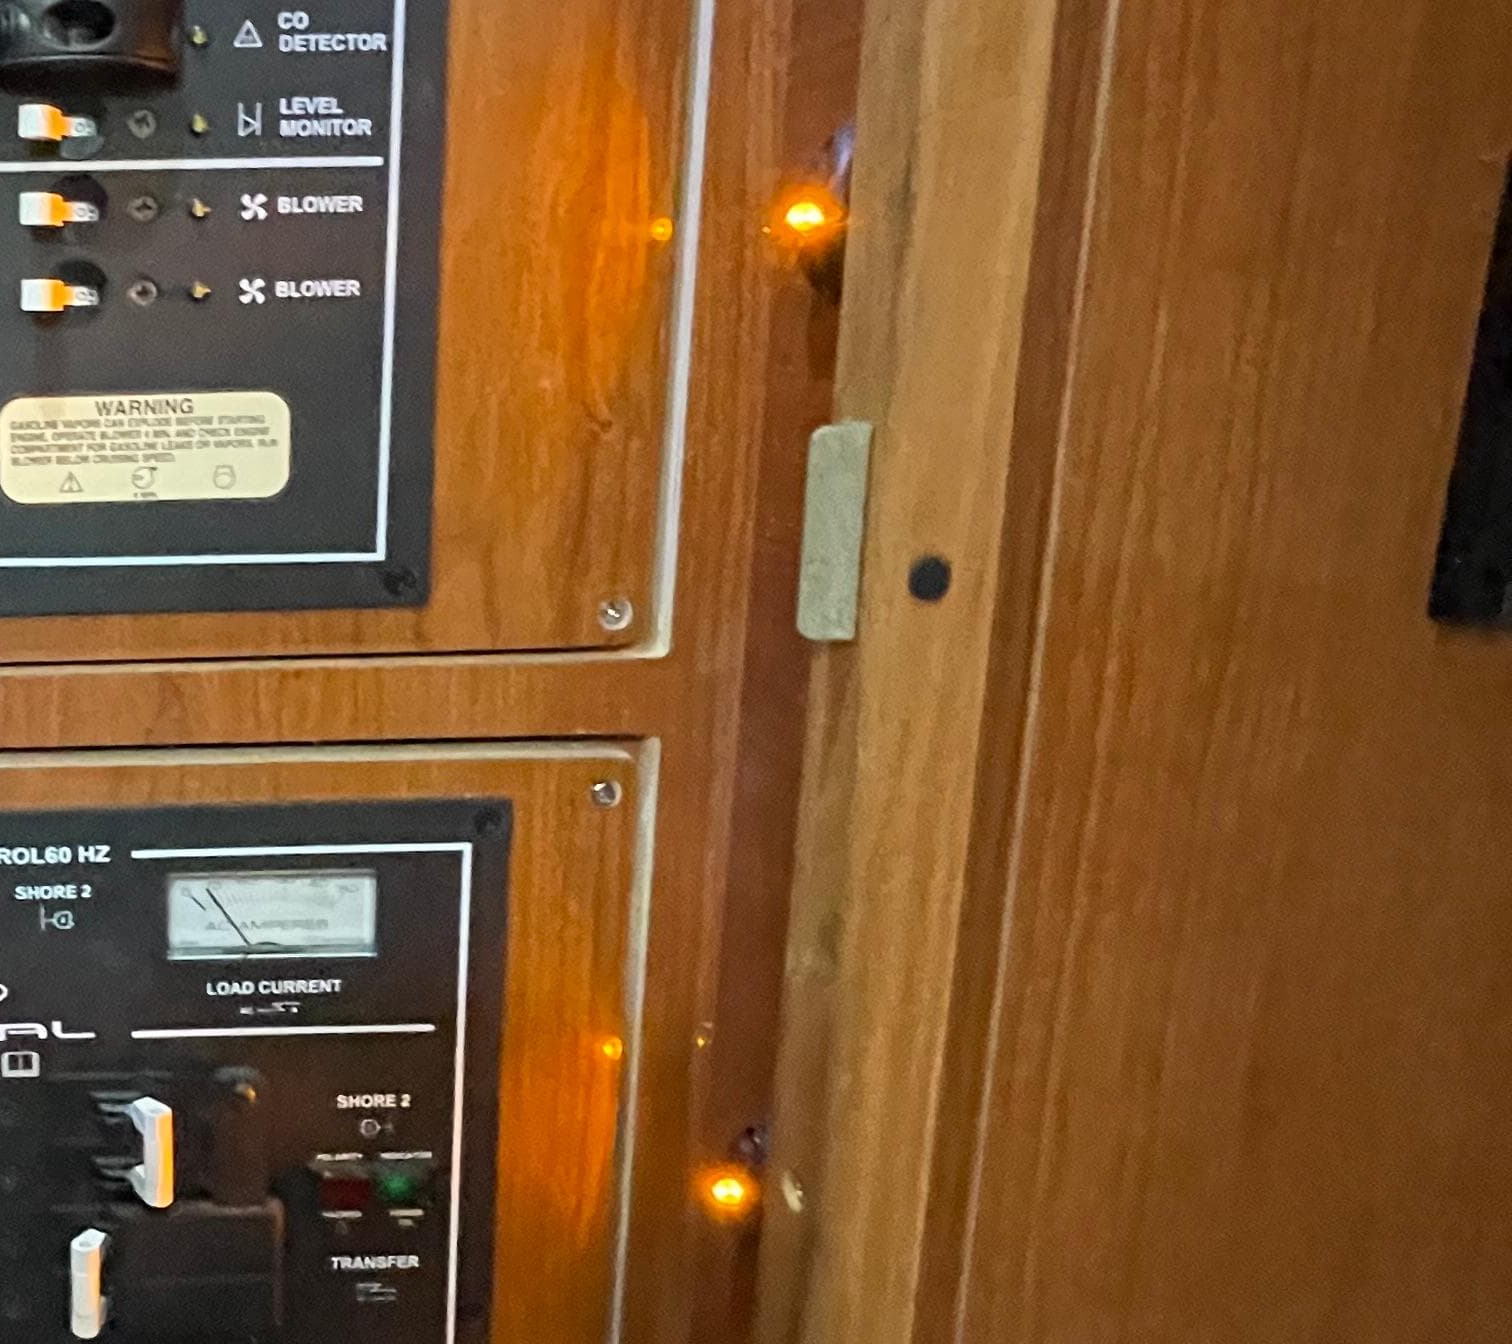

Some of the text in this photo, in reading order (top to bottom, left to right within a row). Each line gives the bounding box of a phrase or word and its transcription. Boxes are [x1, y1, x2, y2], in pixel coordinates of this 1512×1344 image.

[278, 11, 309, 30] CO
[279, 33, 387, 52] DETECTOR
[279, 97, 343, 115] LEVEL
[280, 119, 372, 137] MONITOR
[277, 196, 363, 214] BLOWER
[274, 279, 361, 298] BLOWER
[95, 398, 194, 417] WARNING
[78, 845, 111, 863] HZ
[15, 884, 92, 900] SHORE 2
[206, 979, 342, 996] LOAD CURRENT
[337, 1093, 411, 1109] SHORE 2
[331, 1255, 419, 1270] TRANSFER
